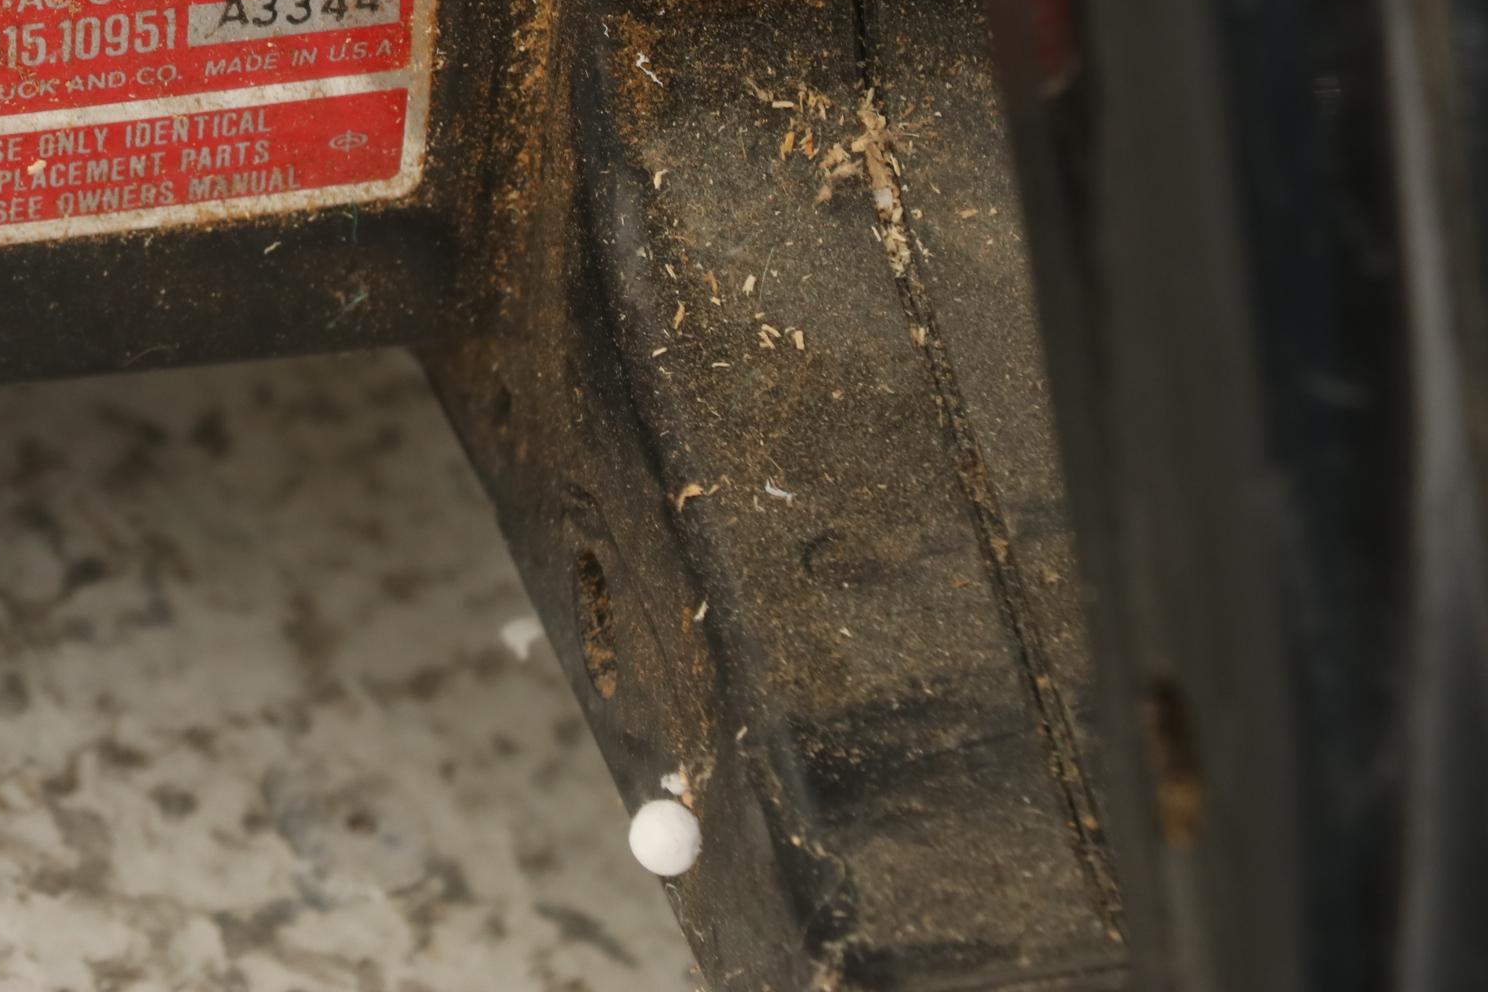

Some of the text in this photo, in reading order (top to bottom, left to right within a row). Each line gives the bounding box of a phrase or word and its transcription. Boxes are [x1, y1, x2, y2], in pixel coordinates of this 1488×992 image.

[67, 70, 127, 93] AND
[135, 63, 183, 86] CO.
[203, 52, 280, 77] MADE
[291, 47, 318, 67] IN
[38, 127, 110, 159] ONLY
[124, 108, 272, 150] IDENTICAL
[179, 139, 272, 173] PARTS
[58, 181, 177, 218] OWNERS
[187, 165, 301, 202] MANUAL
